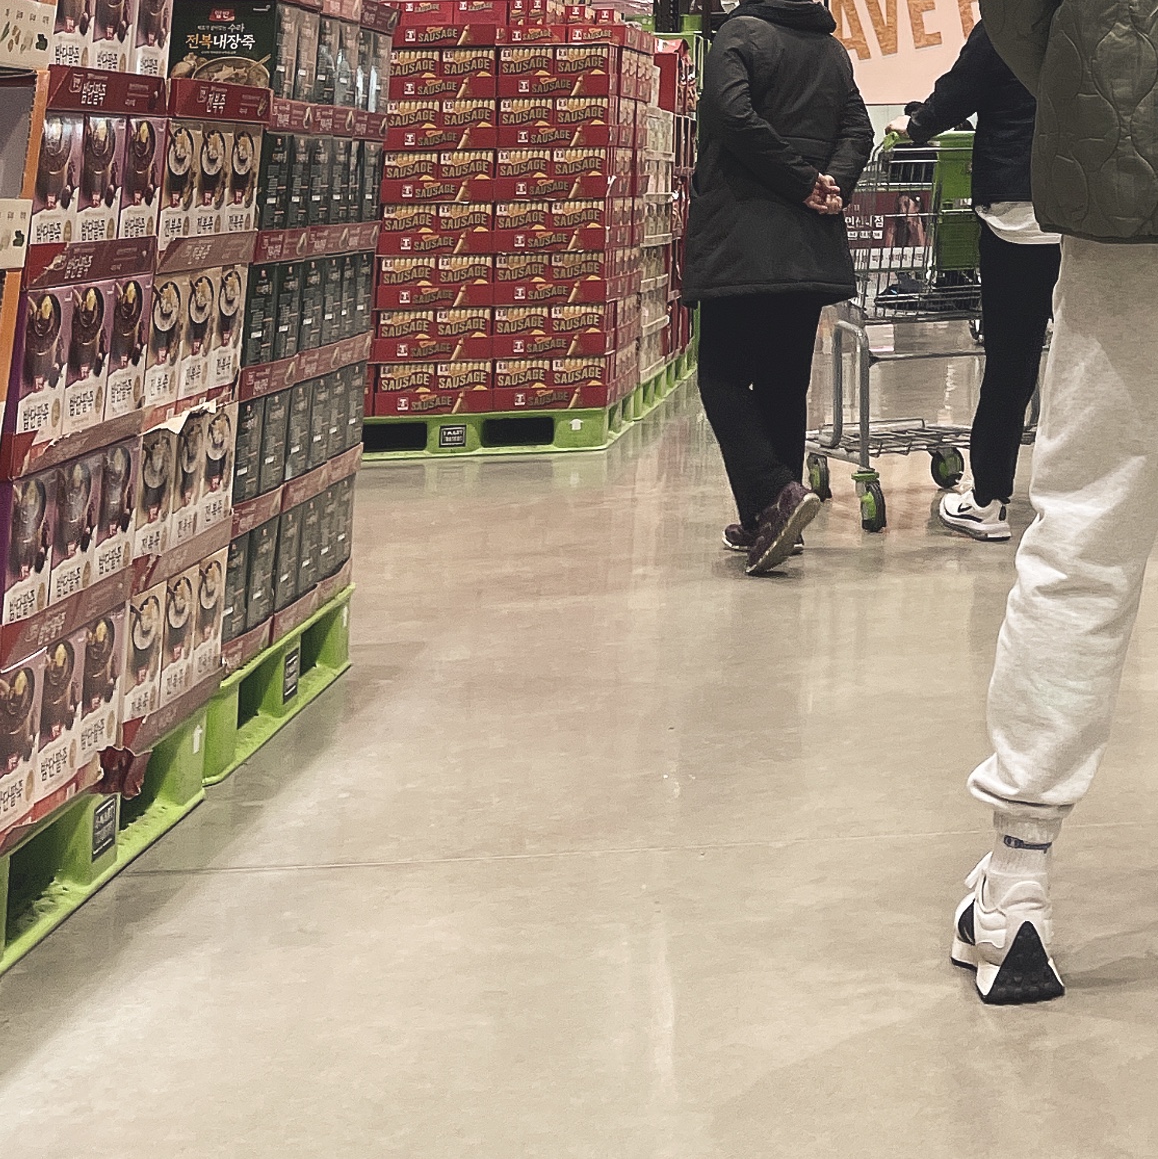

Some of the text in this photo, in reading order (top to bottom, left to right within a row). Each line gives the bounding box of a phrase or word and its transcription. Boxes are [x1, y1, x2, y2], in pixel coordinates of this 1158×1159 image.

[185, 33, 255, 49] 전복내장죽
[418, 28, 458, 42] SAUSAGE
[522, 29, 552, 41] SAUSAGE
[582, 29, 612, 40] SAUSAGE
[390, 60, 435, 76] SAUSAGE
[444, 59, 490, 74] SAUSAGE
[502, 58, 548, 74] SAUSAGE
[557, 57, 604, 72] SAUSAGE
[206, 92, 227, 114] 전복죽
[389, 110, 435, 126] SAUSAGE
[444, 110, 491, 126] SAUSAGE
[502, 108, 548, 126] SAUSAGE
[557, 106, 604, 124] SAUSAGE
[417, 132, 458, 146] SAUSAGE
[530, 130, 570, 144] SAUSAGE
[386, 162, 433, 178] SAUSAGE
[441, 161, 488, 178] SAUSAGE
[500, 160, 546, 177] SAUSAGE
[555, 158, 602, 174] SAUSAGE
[415, 184, 456, 198] SAUSAGE
[530, 180, 569, 194] SAUSAGE
[384, 216, 432, 232] SAUSAGE
[440, 214, 487, 231] SAUSAGE
[498, 212, 545, 230] SAUSAGE
[554, 210, 600, 227] SAUSAGE
[414, 237, 454, 252] SAUSAGE
[527, 234, 568, 248] SAUSAGE
[382, 268, 431, 285] SAUSAGE
[438, 267, 487, 284] SAUSAGE
[497, 264, 545, 282] SAUSAGE
[552, 262, 600, 280] SAUSAGE
[412, 289, 454, 304] SAUSAGE
[528, 286, 568, 300] SAUSAGE
[382, 321, 430, 338] SAUSAGE
[436, 320, 486, 336] SAUSAGE
[496, 316, 544, 334] SAUSAGE
[552, 314, 600, 332] SAUSAGE
[411, 343, 451, 357] SAUSAGE
[526, 339, 567, 353] SAUSAGE
[382, 374, 430, 391] SAUSAGE
[438, 372, 487, 390] SAUSAGE
[497, 368, 545, 386] SAUSAGE
[553, 367, 601, 384] SAUSAGE
[411, 396, 452, 411] SAUSAGE
[528, 392, 569, 406] SAUSAGE
